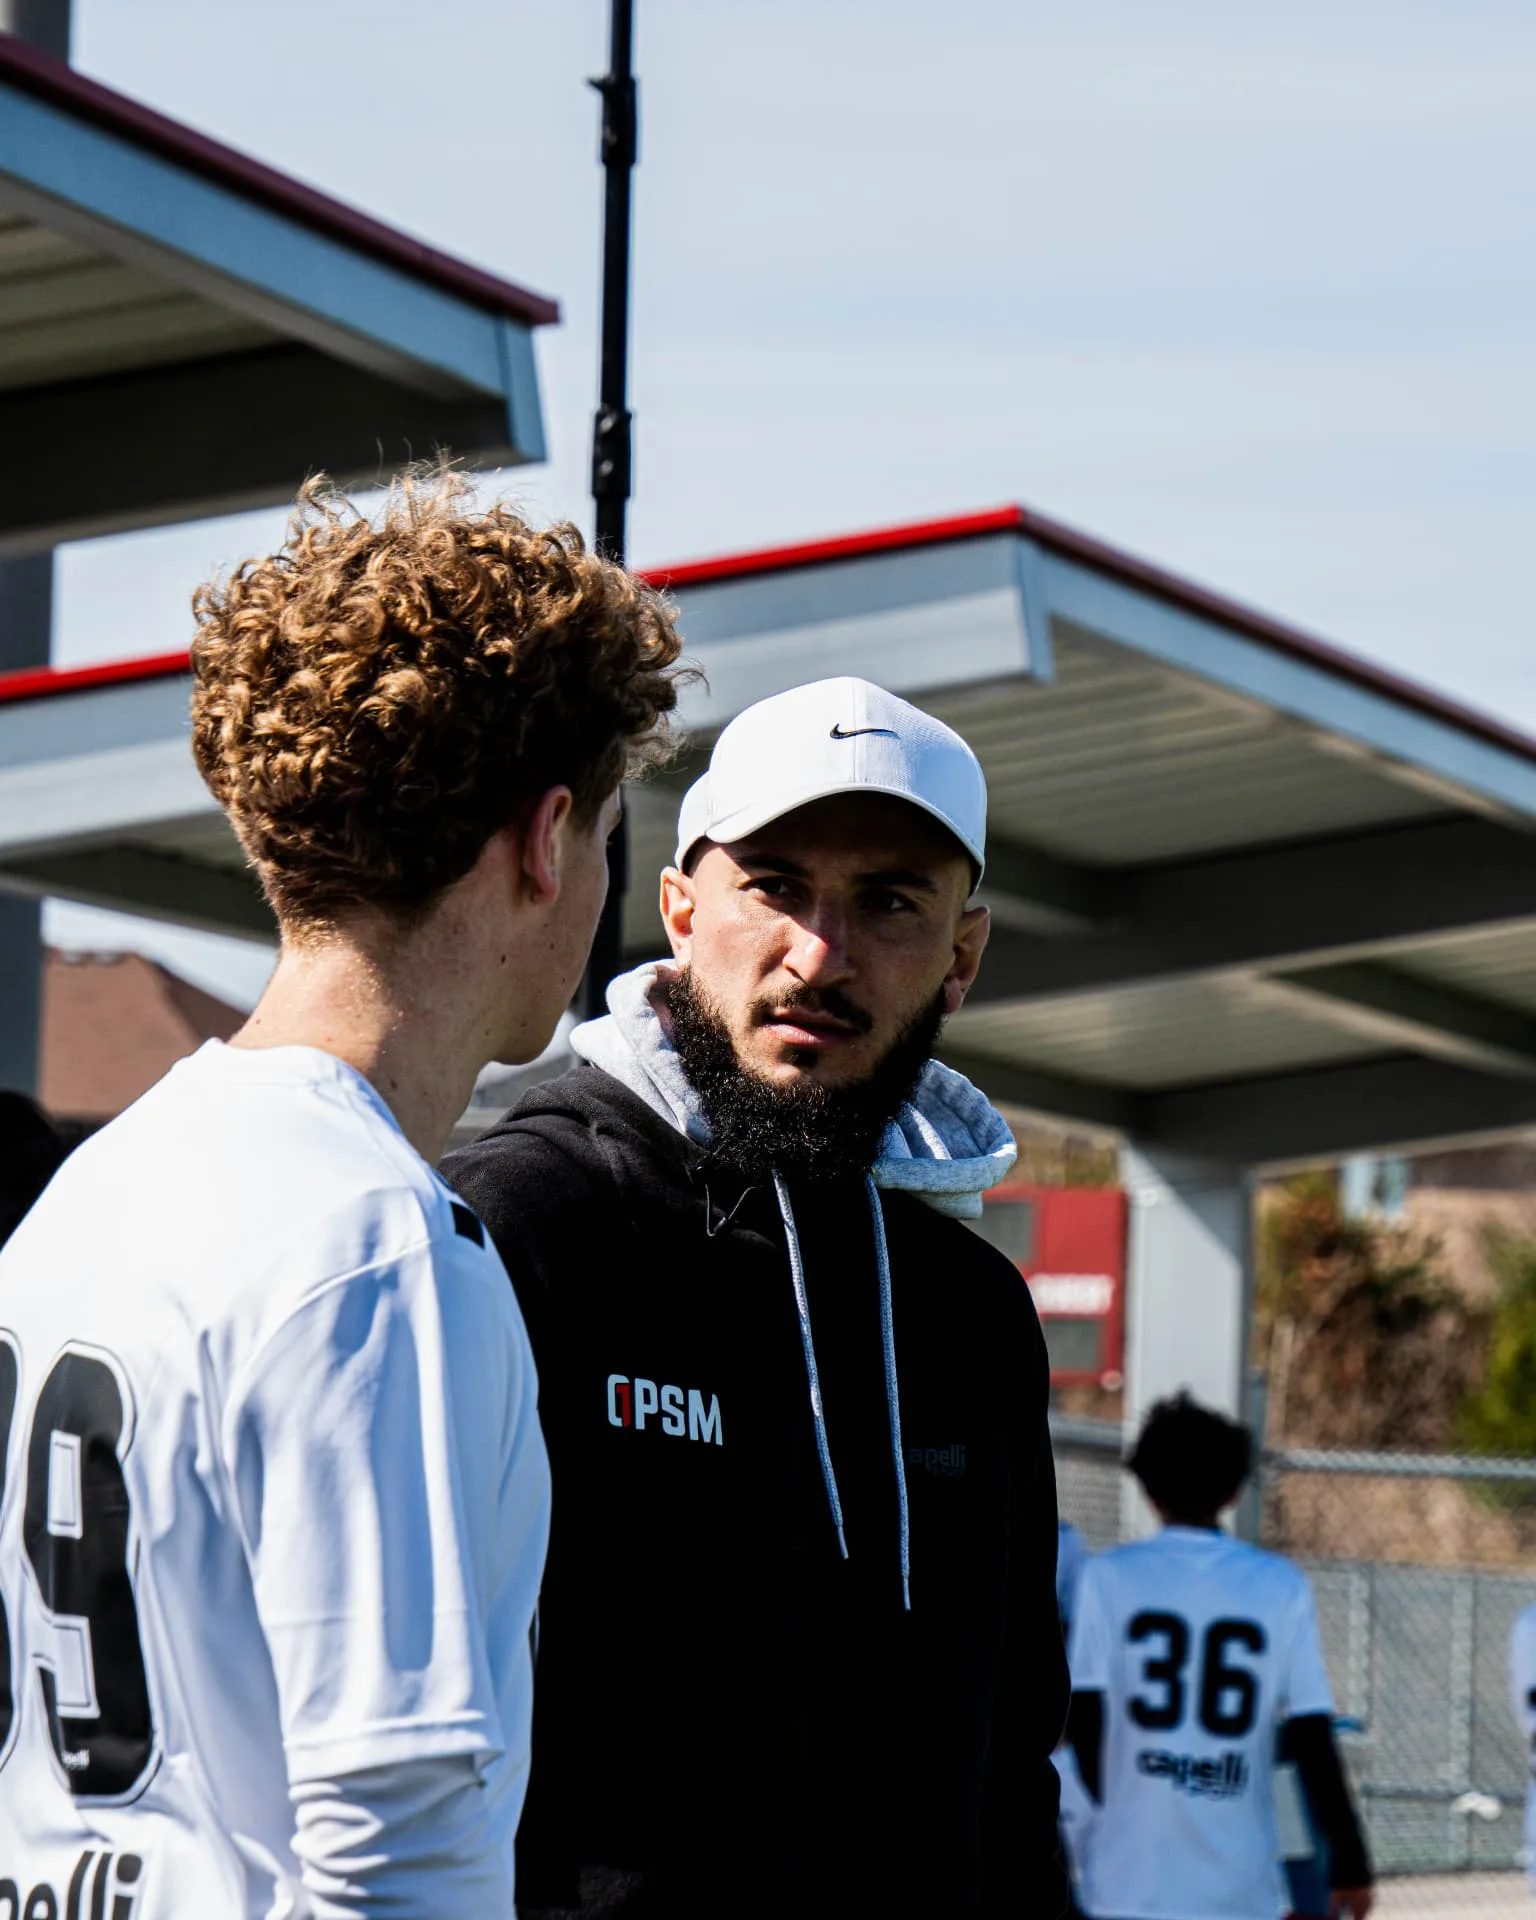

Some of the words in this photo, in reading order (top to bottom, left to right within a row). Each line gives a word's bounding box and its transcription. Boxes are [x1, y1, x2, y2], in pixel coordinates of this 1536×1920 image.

[905, 1444, 966, 1471] apelli
[0, 1326, 163, 1809] 9
[1125, 1609, 1268, 1739] 36
[0, 1850, 143, 1920] elli
